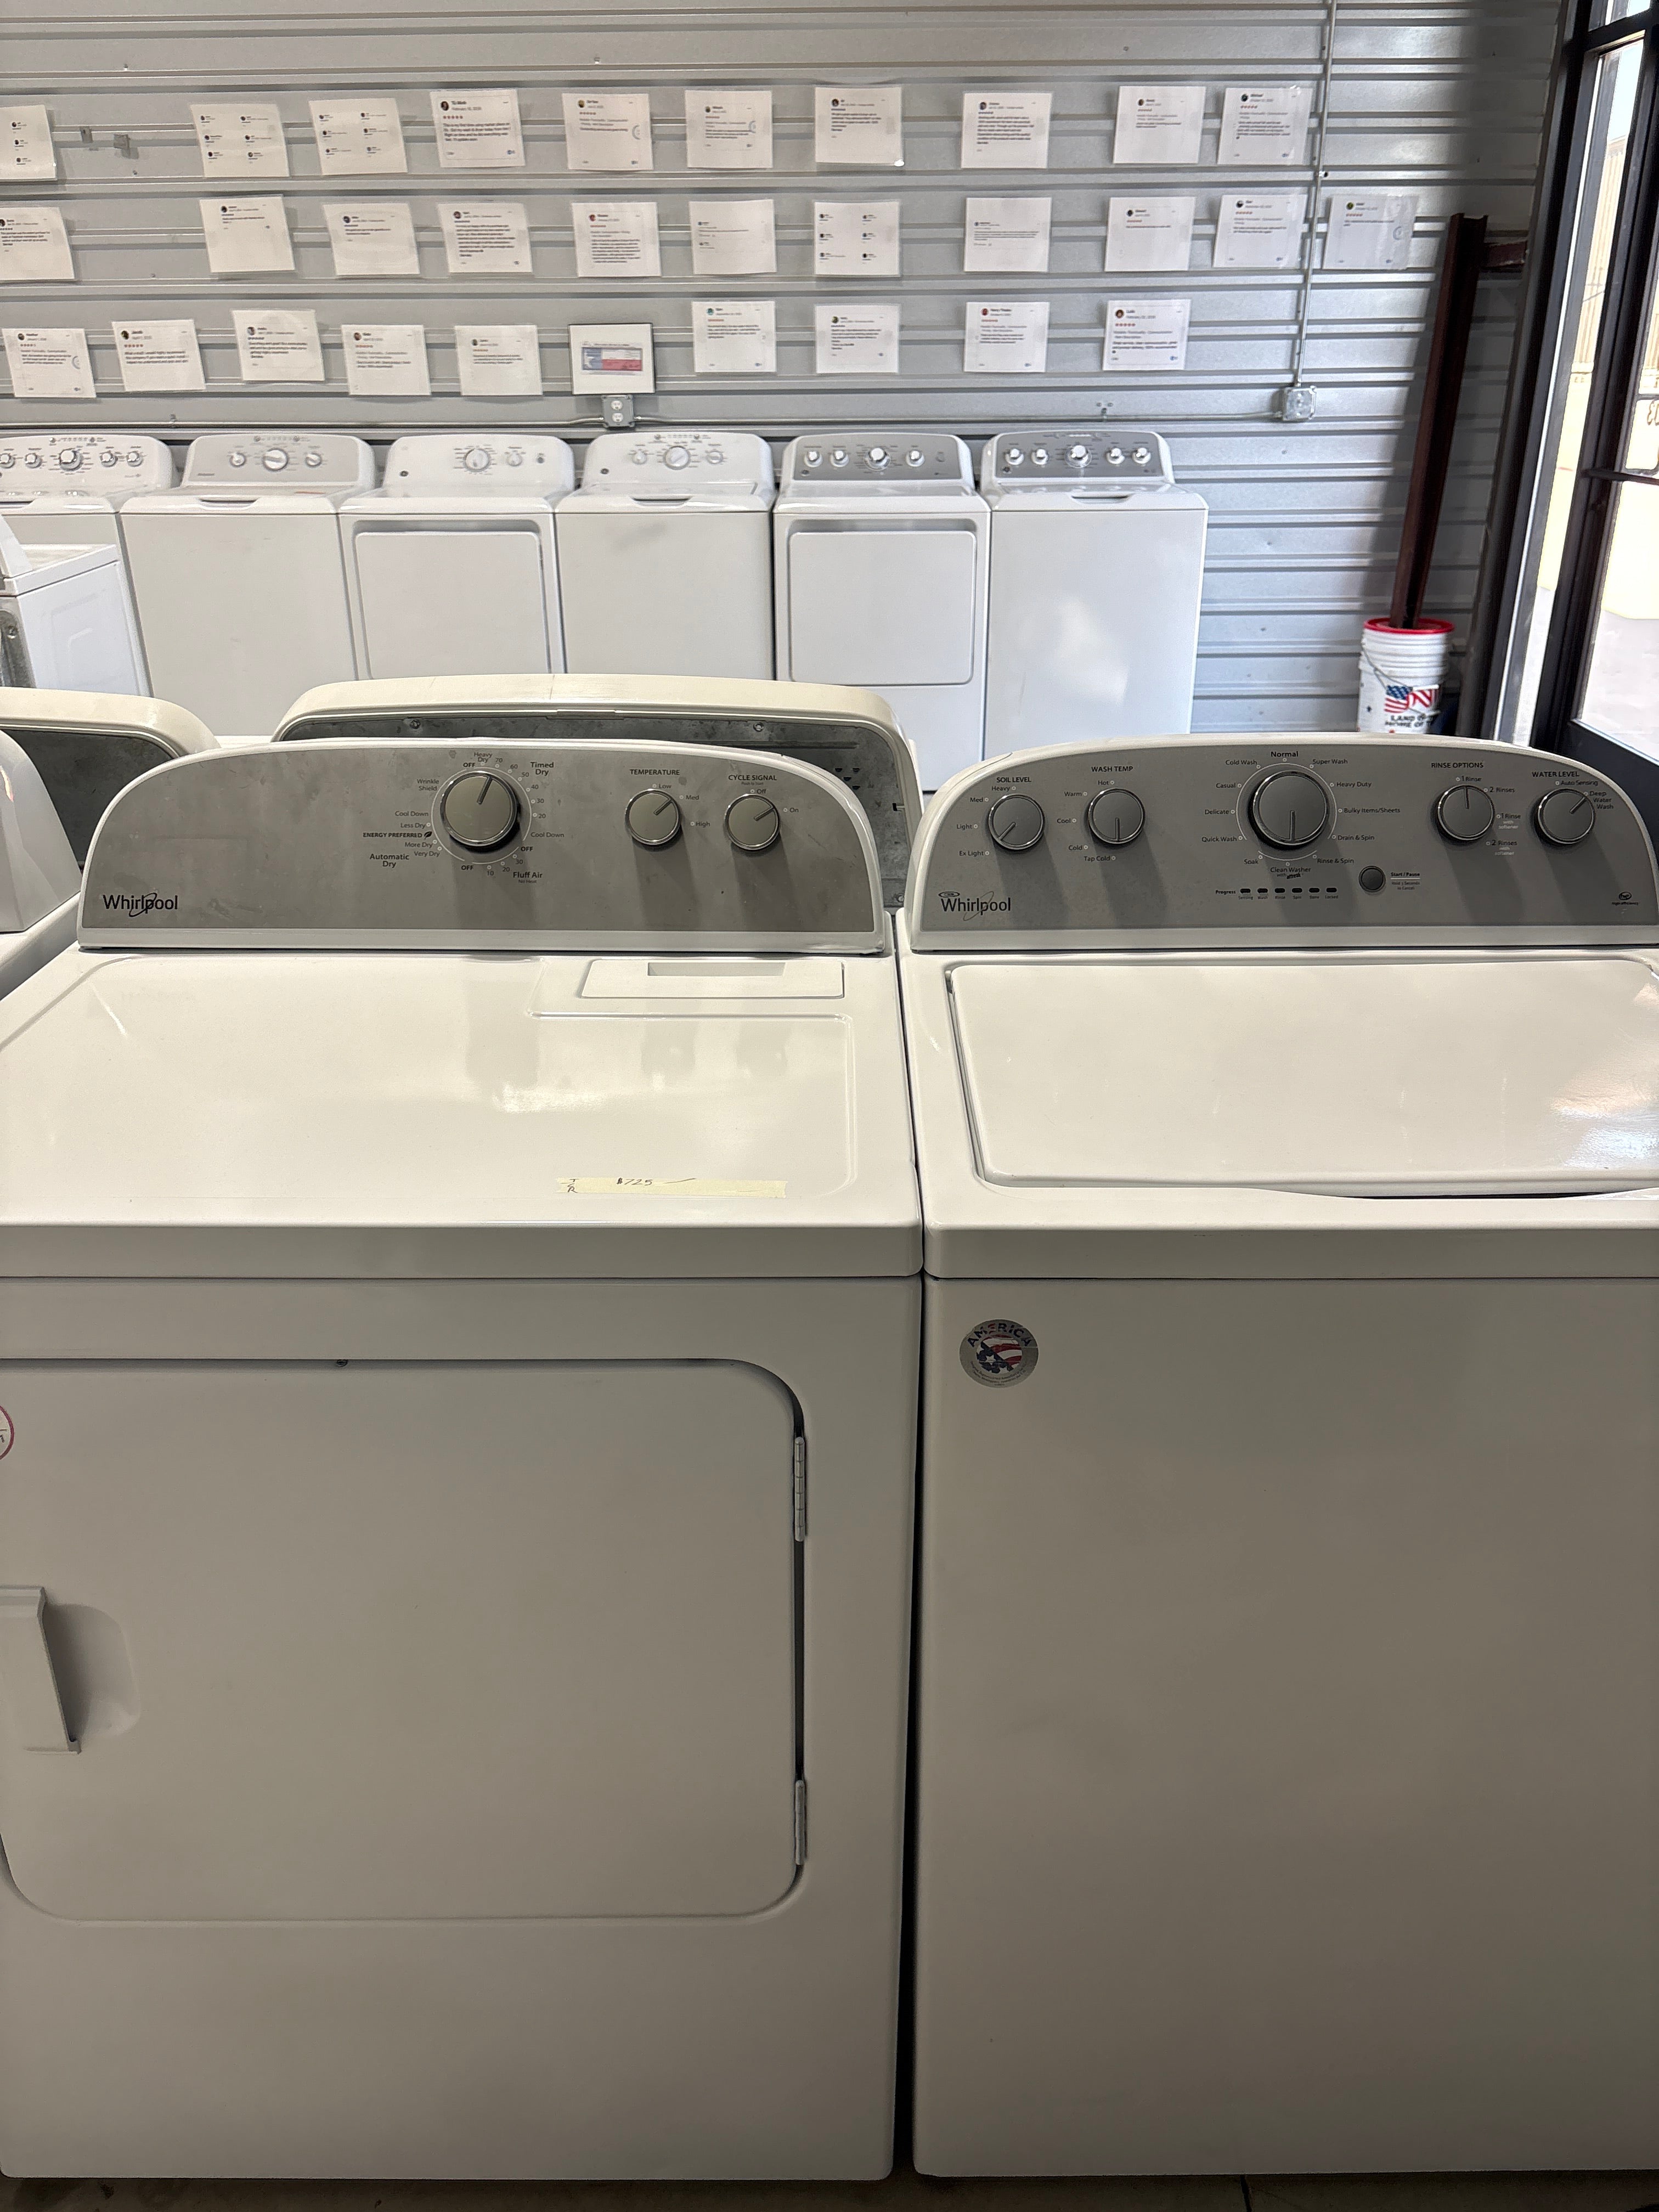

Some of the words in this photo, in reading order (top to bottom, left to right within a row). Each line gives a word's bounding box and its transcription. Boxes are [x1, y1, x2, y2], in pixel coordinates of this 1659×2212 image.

[102, 894, 178, 916] Whirlpool
[940, 896, 1011, 916] Whirlpool
[617, 1177, 653, 1186] $725
[967, 1323, 1031, 1347] AMERICA
